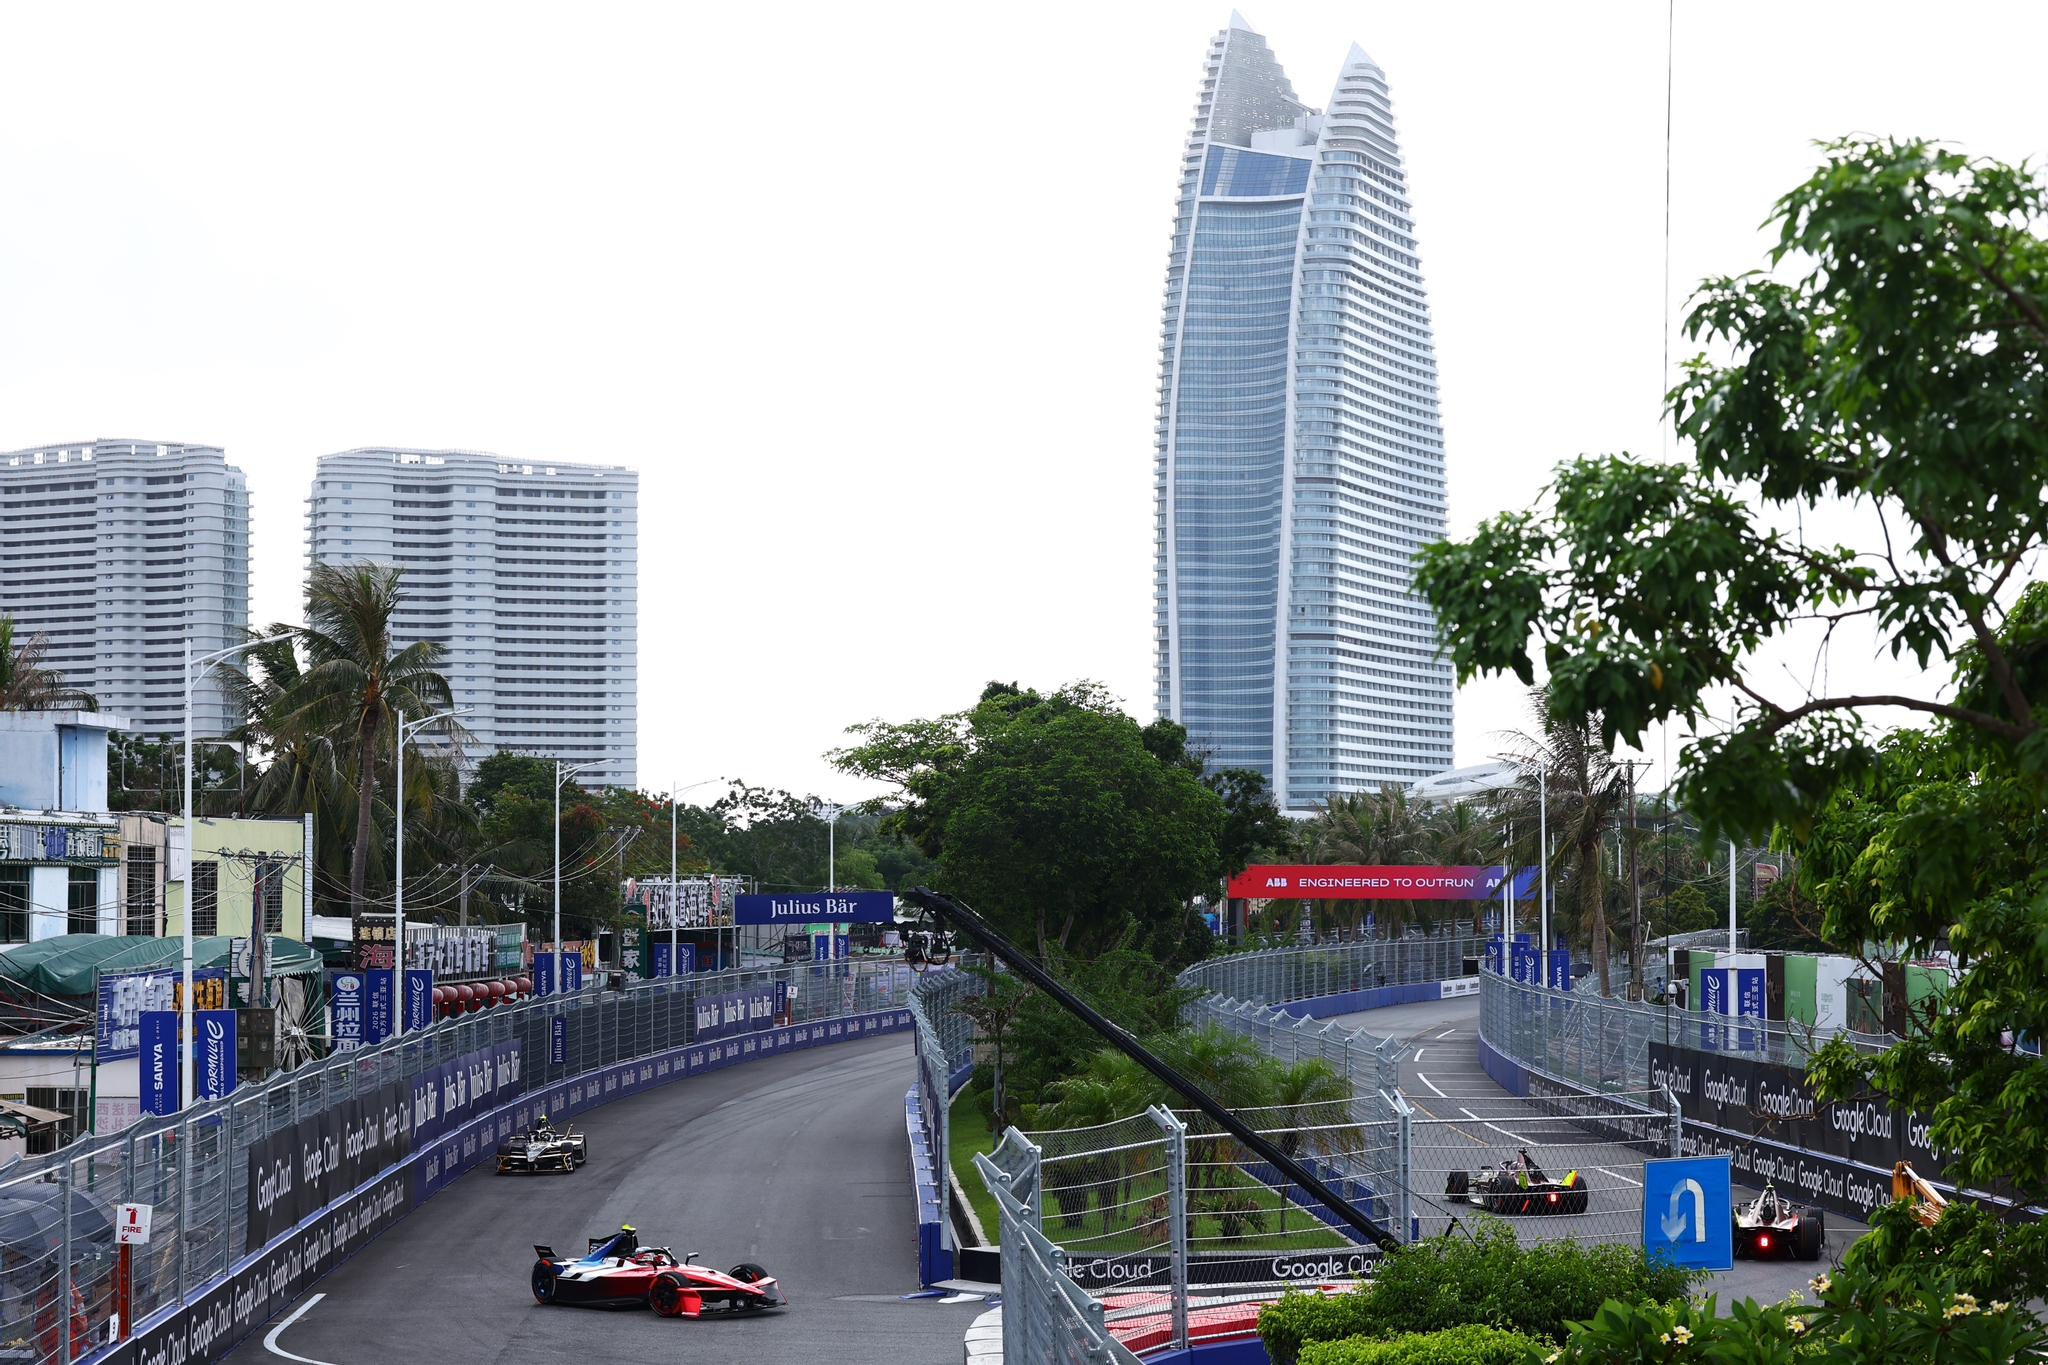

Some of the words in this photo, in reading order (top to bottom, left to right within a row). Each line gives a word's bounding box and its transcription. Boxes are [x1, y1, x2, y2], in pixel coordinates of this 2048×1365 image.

[1266, 878, 1287, 887] ABB
[1299, 878, 1389, 888] ENGINEERED
[1393, 878, 1412, 888] TO
[1415, 878, 1474, 888] OUTRUN
[770, 900, 820, 919] Julius
[825, 898, 858, 914] Bär
[372, 991, 379, 1008] 联信
[336, 991, 361, 1051] 兰州拉面
[554, 1020, 562, 1036] Bär
[153, 1043, 163, 1091] SANYA
[207, 1037, 218, 1093] FORMULA
[554, 1038, 563, 1063] Julius
[1674, 1066, 1691, 1093] Cloud
[1704, 1069, 1728, 1110] Google
[1729, 1076, 1747, 1106] Cloud
[1759, 1081, 1789, 1122] Google
[1790, 1087, 1814, 1116] Cloud
[1832, 1100, 1864, 1142] Google
[1865, 1103, 1892, 1139] Cloud
[1735, 1145, 1750, 1171] Cloud
[1753, 1148, 1775, 1183] Google
[1777, 1154, 1795, 1183] Cloud
[1799, 1160, 1822, 1198] Google
[1823, 1167, 1843, 1198] Cloud
[1847, 1173, 1873, 1213] Google
[1875, 1183, 1892, 1208] Clou
[1090, 1258, 1151, 1278] Cloud
[1272, 1254, 1343, 1280] Google
[234, 1277, 254, 1325] Google
[254, 1267, 269, 1311] Cloud
[166, 1324, 187, 1364] Cloud
[190, 1306, 213, 1357] Google
[214, 1293, 232, 1338] Cloud
